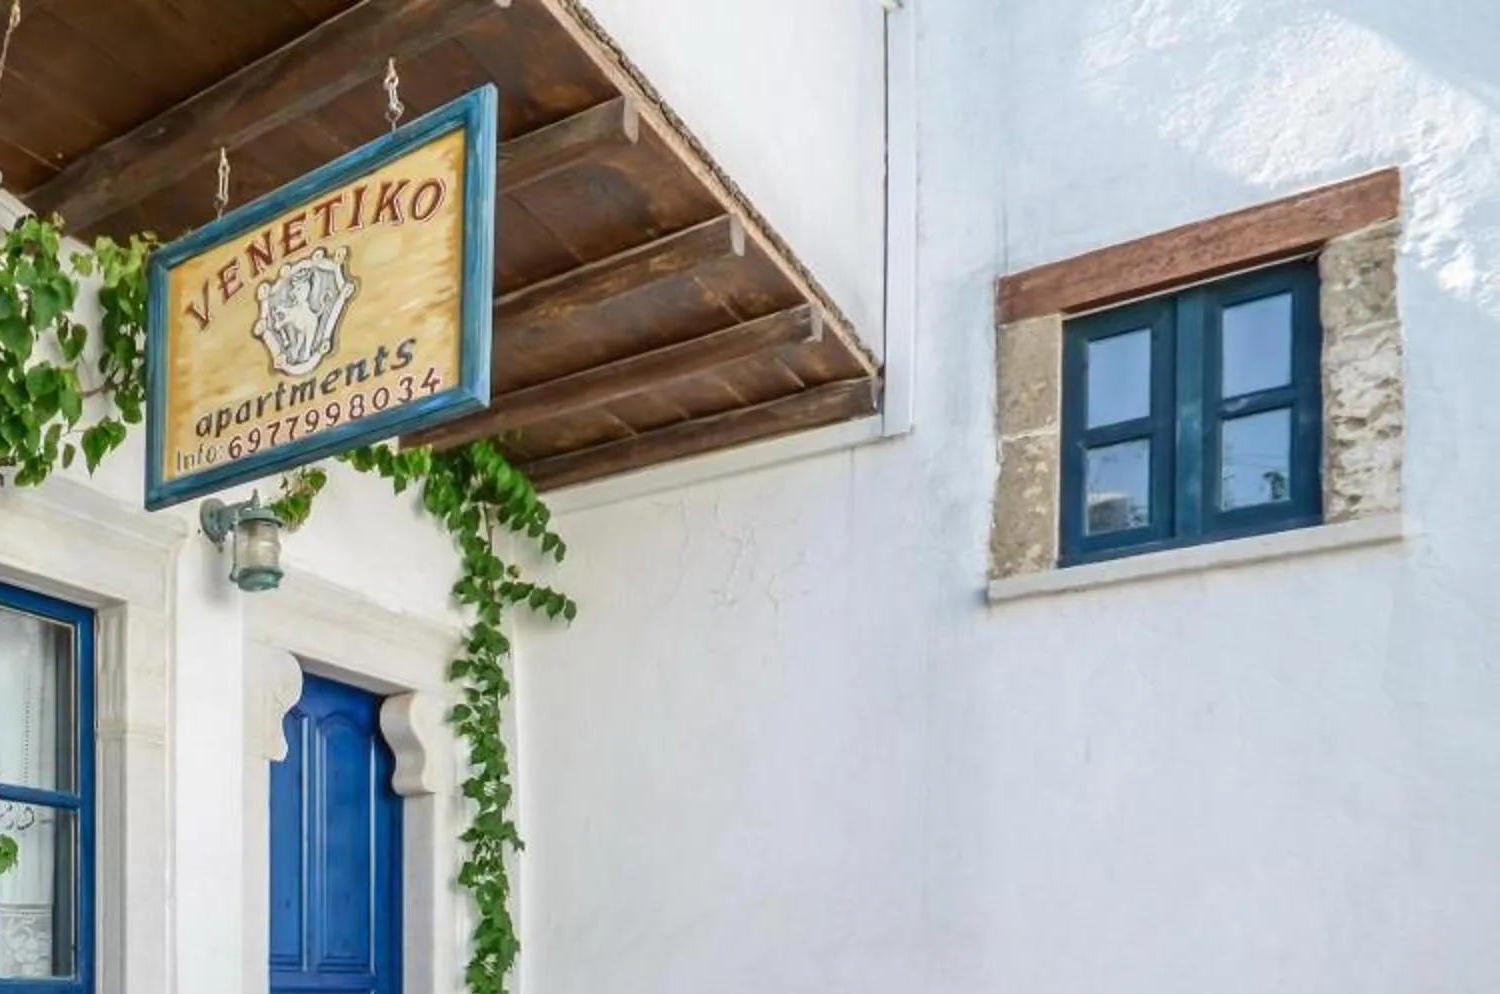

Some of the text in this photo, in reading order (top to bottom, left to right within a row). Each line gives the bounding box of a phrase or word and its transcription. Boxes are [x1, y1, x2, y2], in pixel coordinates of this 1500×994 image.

[185, 178, 447, 331] VENETIKO
[195, 337, 417, 438] apartments
[227, 367, 441, 460] 6977998034
